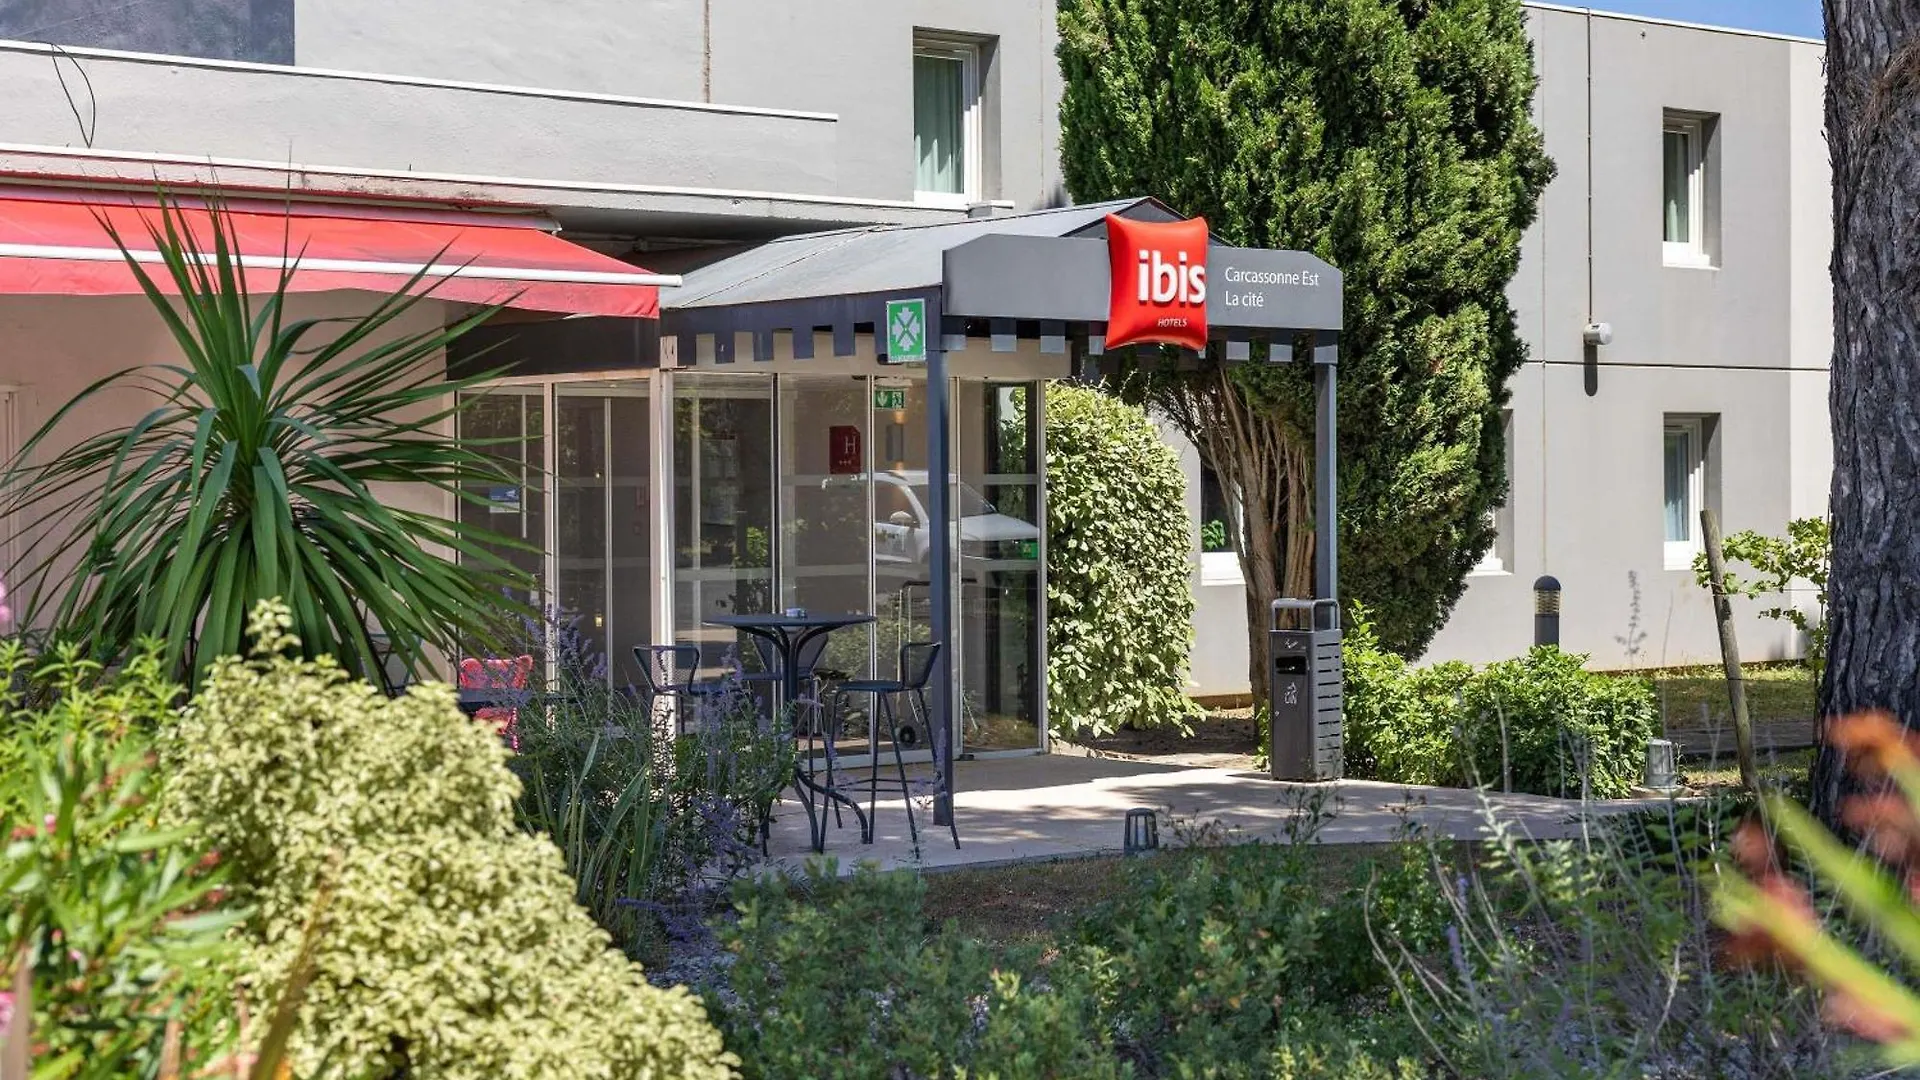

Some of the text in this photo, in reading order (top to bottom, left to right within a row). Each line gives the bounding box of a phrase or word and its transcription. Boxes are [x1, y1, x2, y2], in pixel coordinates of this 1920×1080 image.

[1138, 250, 1206, 303] ibis
[1225, 267, 1319, 286] Carcassonne Est
[1225, 291, 1264, 307] La cité
[1158, 318, 1188, 328] HOTELS
[845, 435, 856, 454] H
